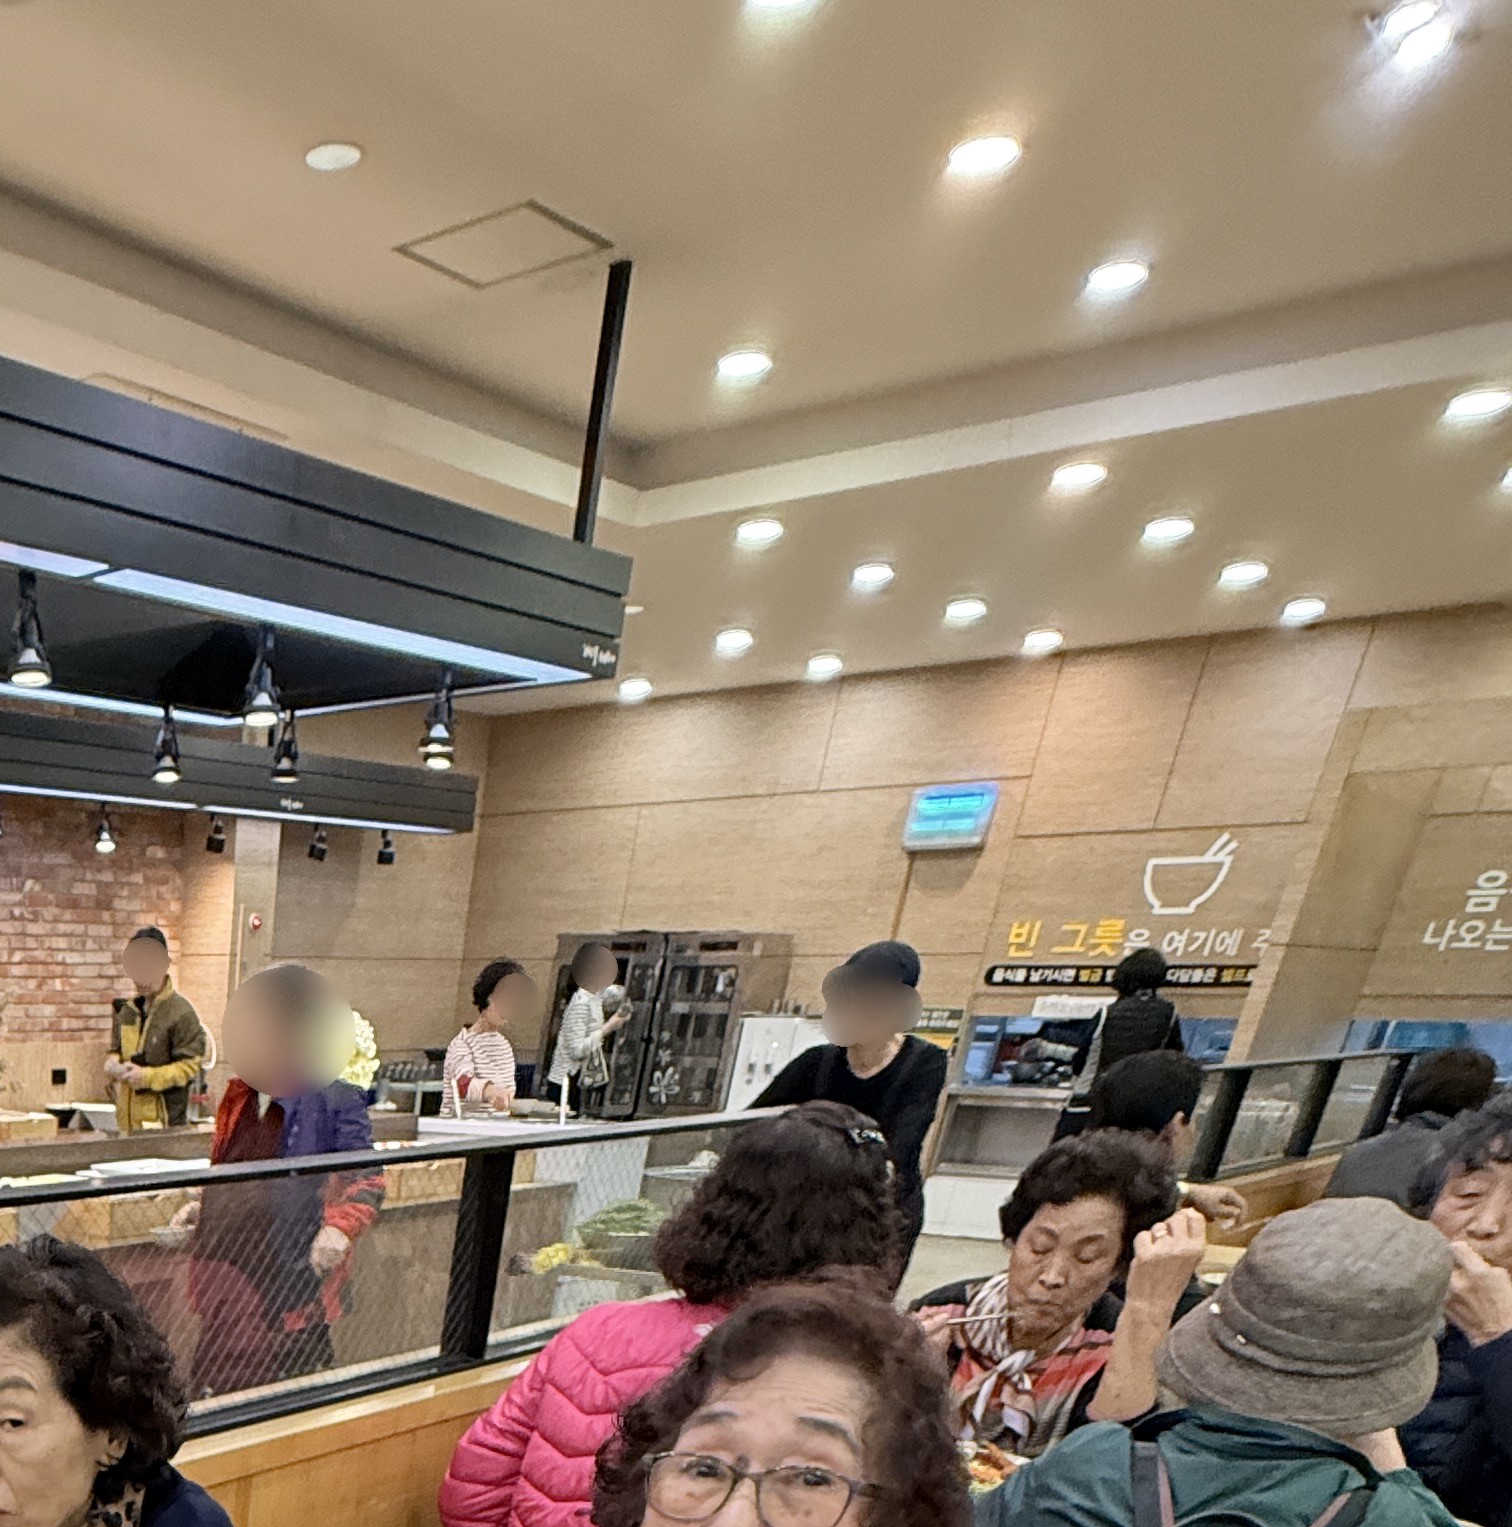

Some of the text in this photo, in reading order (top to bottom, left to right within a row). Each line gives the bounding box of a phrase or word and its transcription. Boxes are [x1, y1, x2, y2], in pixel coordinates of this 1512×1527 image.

[1008, 919, 1042, 958] 빈
[1050, 918, 1151, 957] 그릇은
[1161, 927, 1244, 958] 여기에
[1422, 918, 1512, 951] 나오는
